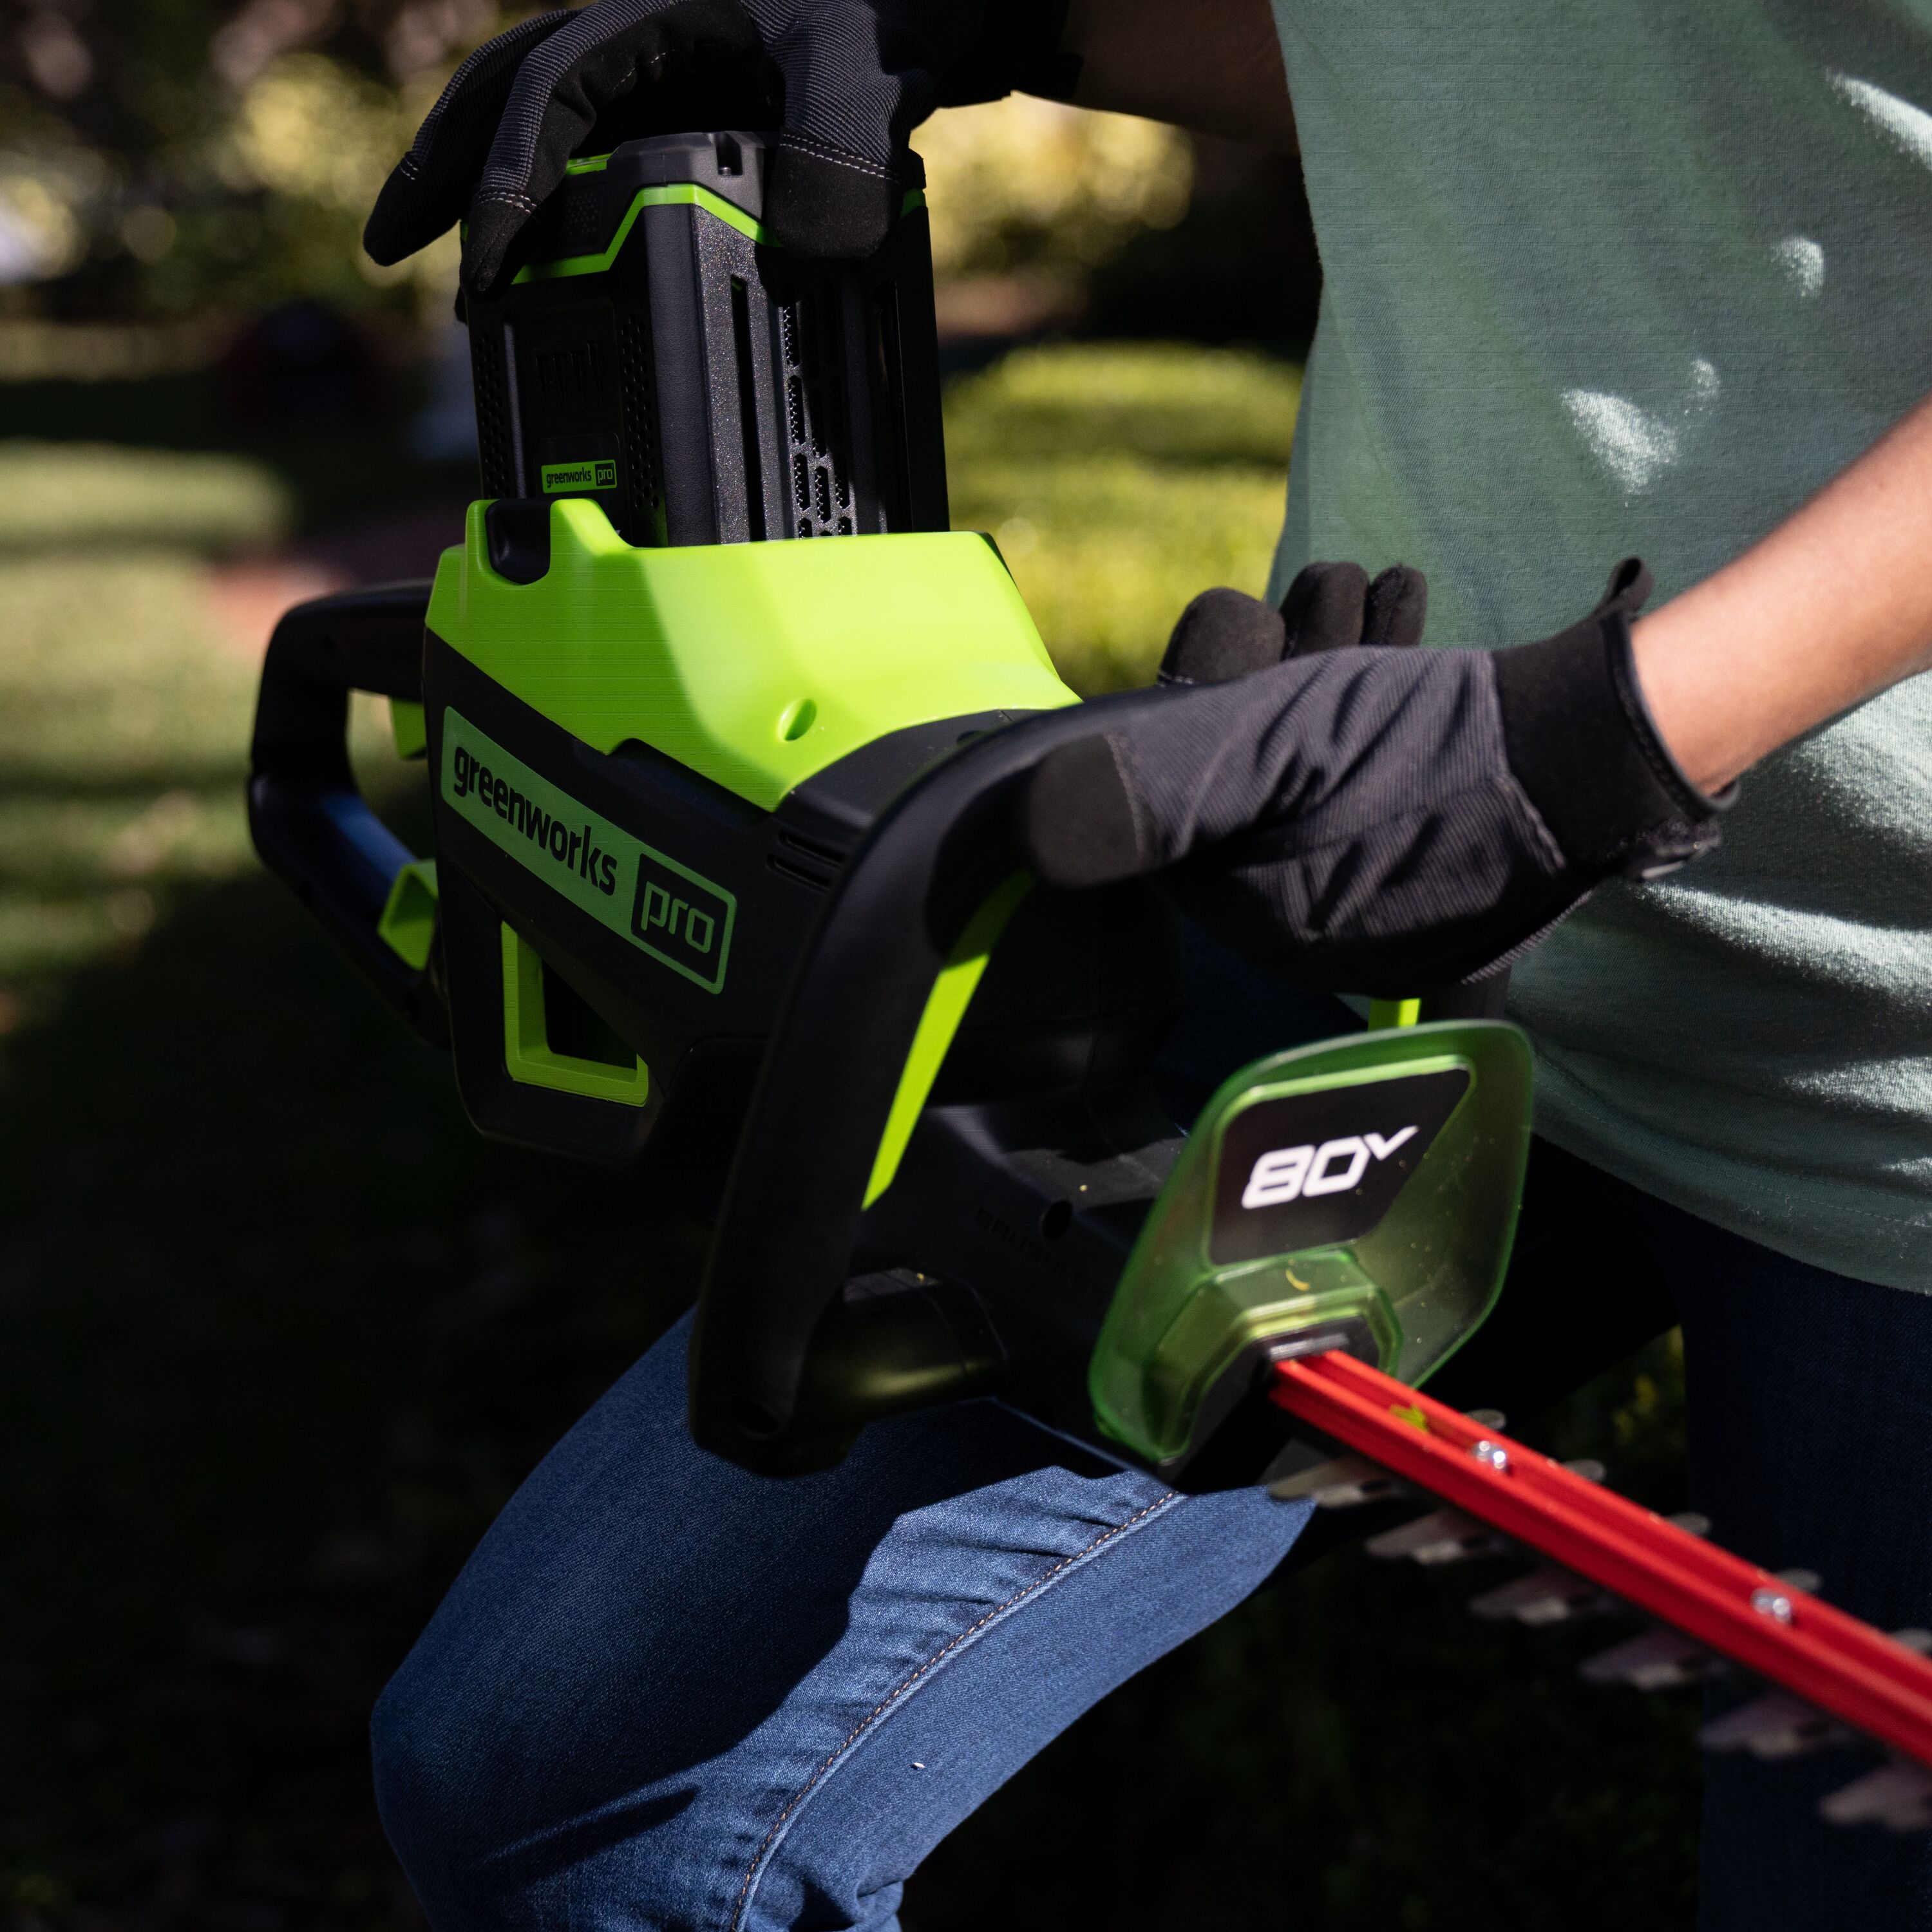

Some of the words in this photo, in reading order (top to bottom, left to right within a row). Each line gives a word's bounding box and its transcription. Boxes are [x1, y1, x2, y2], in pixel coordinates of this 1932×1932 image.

[546, 467, 592, 488] greenworks
[597, 468, 613, 484] pro
[454, 746, 618, 896] greenworks
[640, 880, 715, 954] pro
